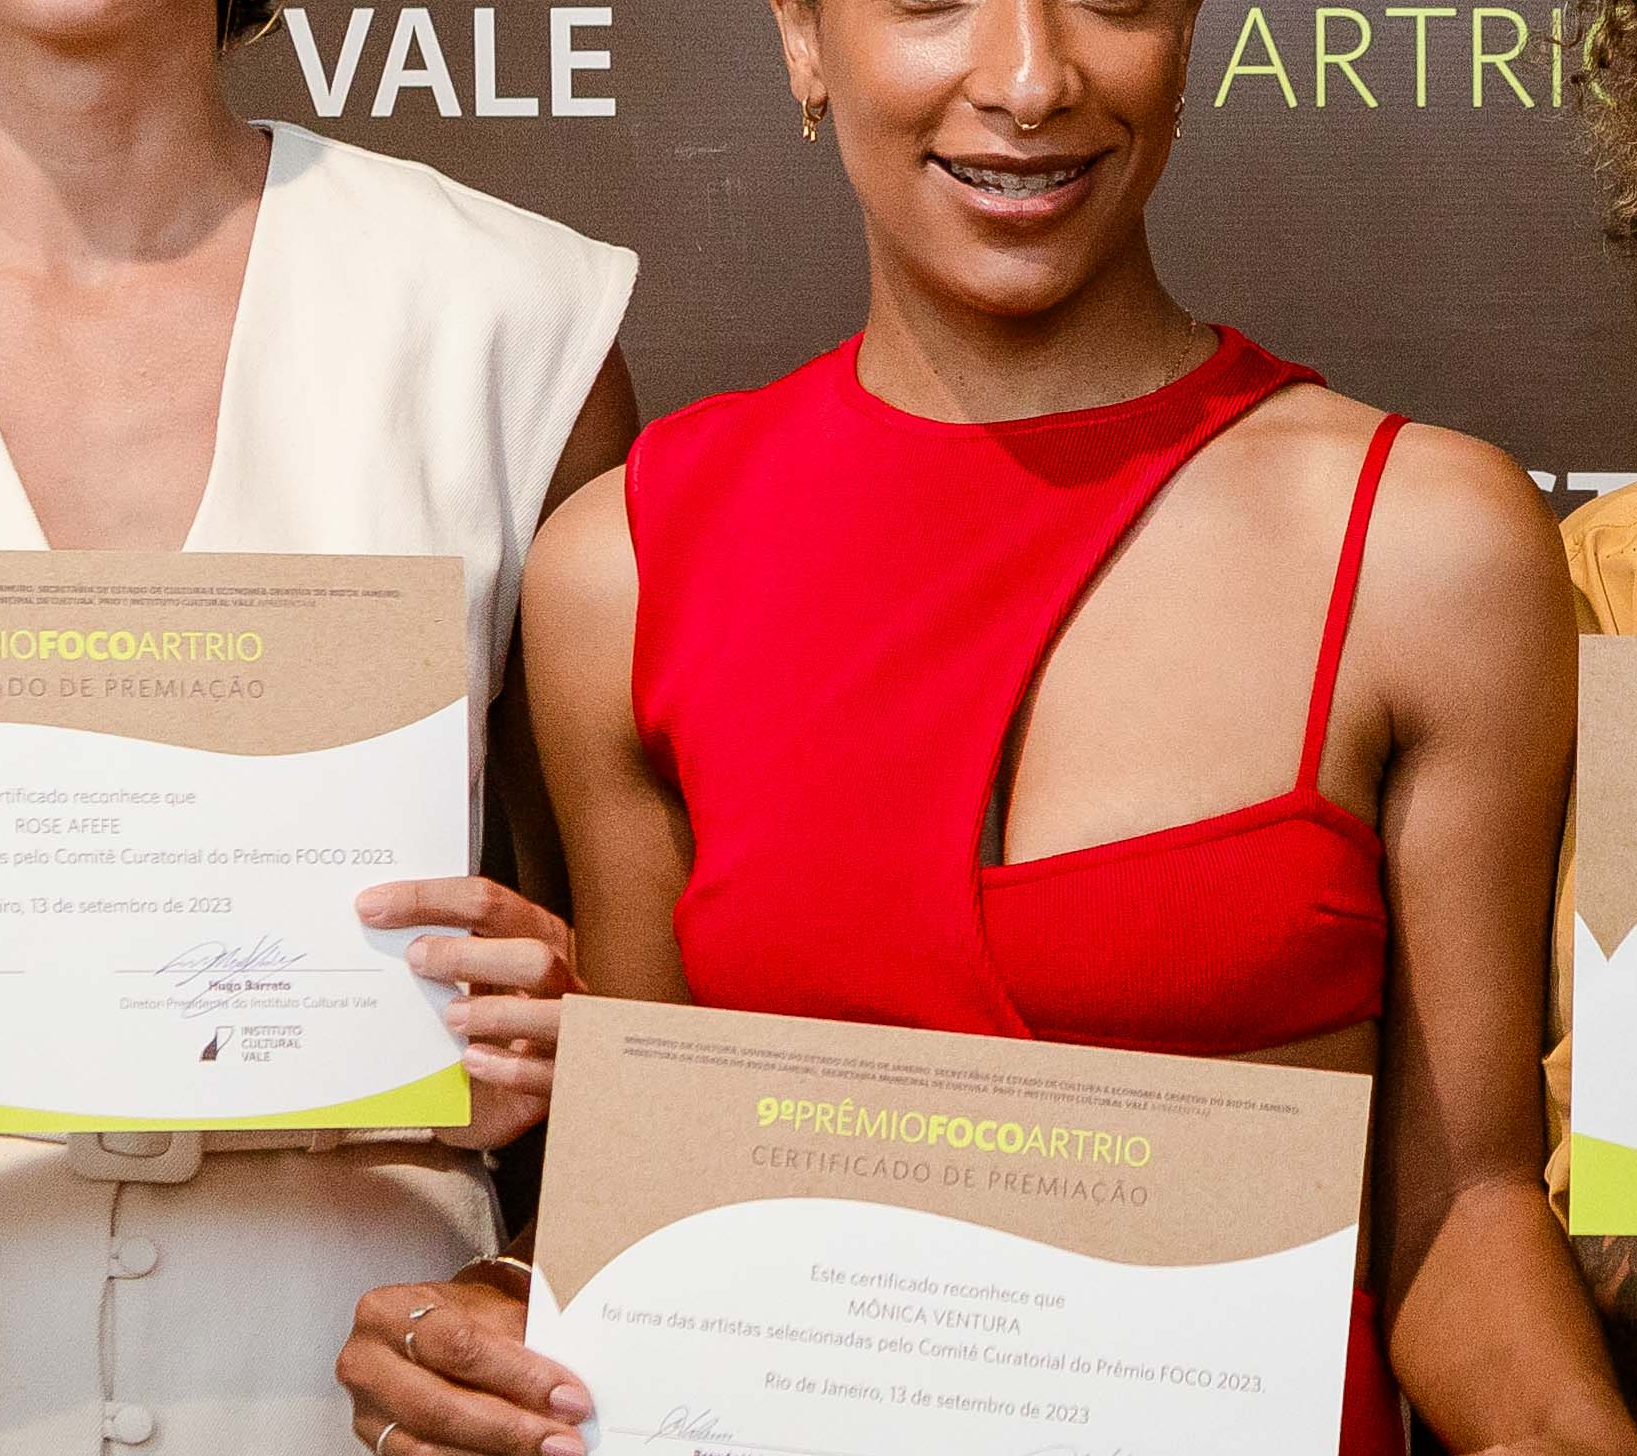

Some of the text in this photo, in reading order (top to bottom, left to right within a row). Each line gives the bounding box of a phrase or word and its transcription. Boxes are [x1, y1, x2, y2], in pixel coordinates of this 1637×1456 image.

[284, 7, 617, 119] VALE
[58, 677, 94, 698] DE
[104, 674, 265, 703] PREMIAÇÃO
[72, 788, 161, 805] reconhece
[163, 791, 197, 806] que
[14, 816, 121, 835] ROSE AFEFE
[750, 1144, 1148, 1207] CERTIFICADO DE PREMIAÇÃO
[809, 1263, 1066, 1309] Este certificado reconhece que
[846, 1297, 1021, 1335] MÔNICA VENTURA
